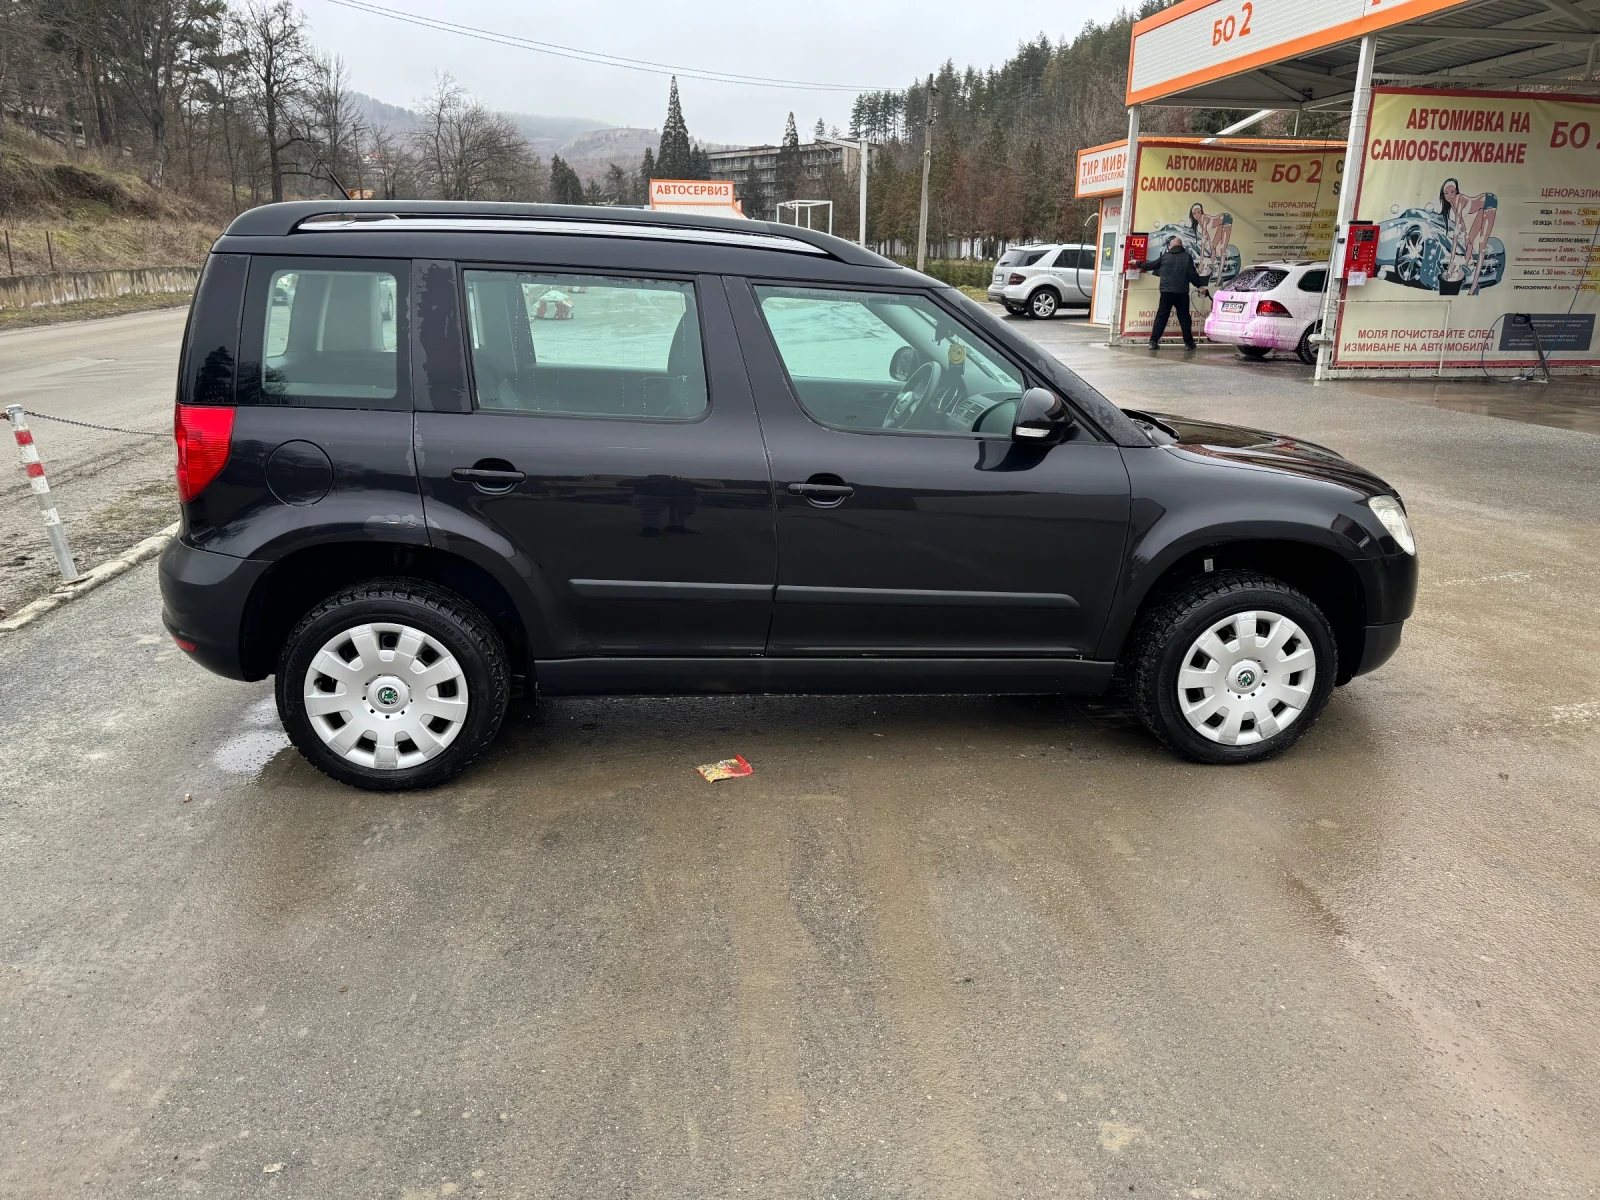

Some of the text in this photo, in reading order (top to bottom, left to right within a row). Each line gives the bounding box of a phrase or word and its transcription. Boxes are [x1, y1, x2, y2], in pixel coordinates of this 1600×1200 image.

[1212, 2, 1253, 46] БО 2
[1406, 108, 1530, 133] АВТОМИВКА НА
[1550, 121, 1591, 149] БО
[1370, 139, 1527, 164] САМООБСЛУЖВАНЕ
[1082, 159, 1099, 177] ТИР
[1166, 155, 1257, 172] АВТОМИВКА НА
[1271, 160, 1322, 183] БО 2
[656, 185, 729, 196] АВТОСЕРВИЗ
[1141, 176, 1254, 194] САМООБСЛУЖВАНЕ
[1357, 329, 1495, 340] МОЛЯ ПОЧИСТВАЙТЕ СЛЕД
[1344, 342, 1494, 352] ИЗМИВАНЕ НА АВТОМОБИЛА!
